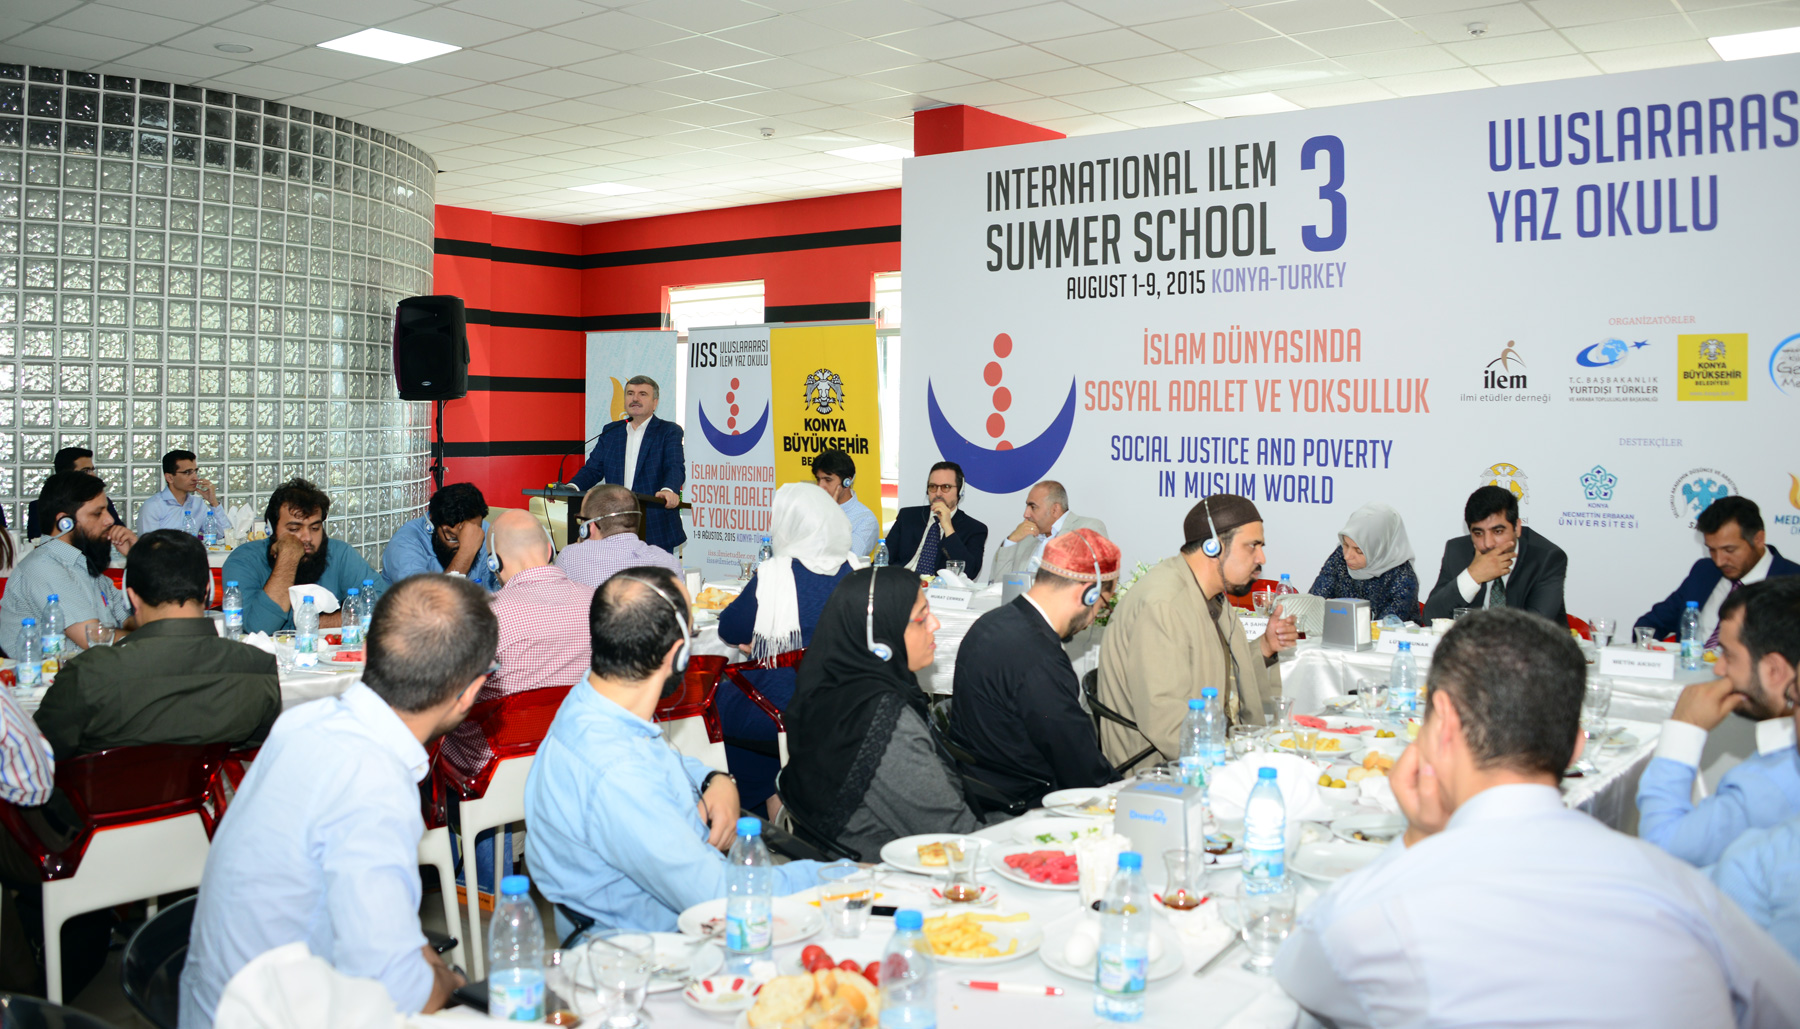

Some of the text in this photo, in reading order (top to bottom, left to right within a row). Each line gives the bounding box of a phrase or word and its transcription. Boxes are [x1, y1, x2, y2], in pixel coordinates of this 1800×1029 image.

[1489, 90, 1799, 171] ULUSLARARAS
[986, 141, 1276, 212] INTERNATIONAL ILEM
[1301, 135, 1347, 252] 3
[1488, 175, 1718, 243] YAZ OKULU
[987, 202, 1276, 272] SUMMER SCHOOL
[1067, 262, 1346, 299] AUGUST 1-9, 2015 KONYA-TURKEY
[1609, 315, 1696, 325] ORGANİZATÖRLER
[691, 342, 717, 367] IISS
[720, 340, 768, 353] ULUSLARARASI
[1144, 325, 1360, 365] İSLAM DÜNYASINDA
[720, 353, 768, 367] İLEM YAZ OKULU
[1484, 370, 1527, 389] ilem
[1683, 369, 1742, 380] BÜYÜKŞEHİR
[1085, 378, 1429, 413] SOSYAL ADALET VE YOKSULLUK
[1515, 394, 1550, 403] derneği
[1569, 385, 1658, 394] YURTDIŞI TÜRKLER
[805, 418, 846, 432] KONYA
[1111, 435, 1392, 468] SOCIAL JUSTICE AND POVERTY
[1619, 438, 1683, 448] DESTEKÇİLER
[692, 461, 774, 482] İSLAM DÜNYASINDA
[690, 484, 773, 507] SOSYAL ADALET
[1159, 470, 1333, 504] IN MUSLIM WORLD
[691, 506, 772, 532] VE YOKSULLUK
[1558, 518, 1639, 529] ÜNİVERSİTESİ
[693, 530, 702, 540] 1-9
[702, 529, 724, 542] AĞUSTOS,
[724, 533, 736, 542] 2015
